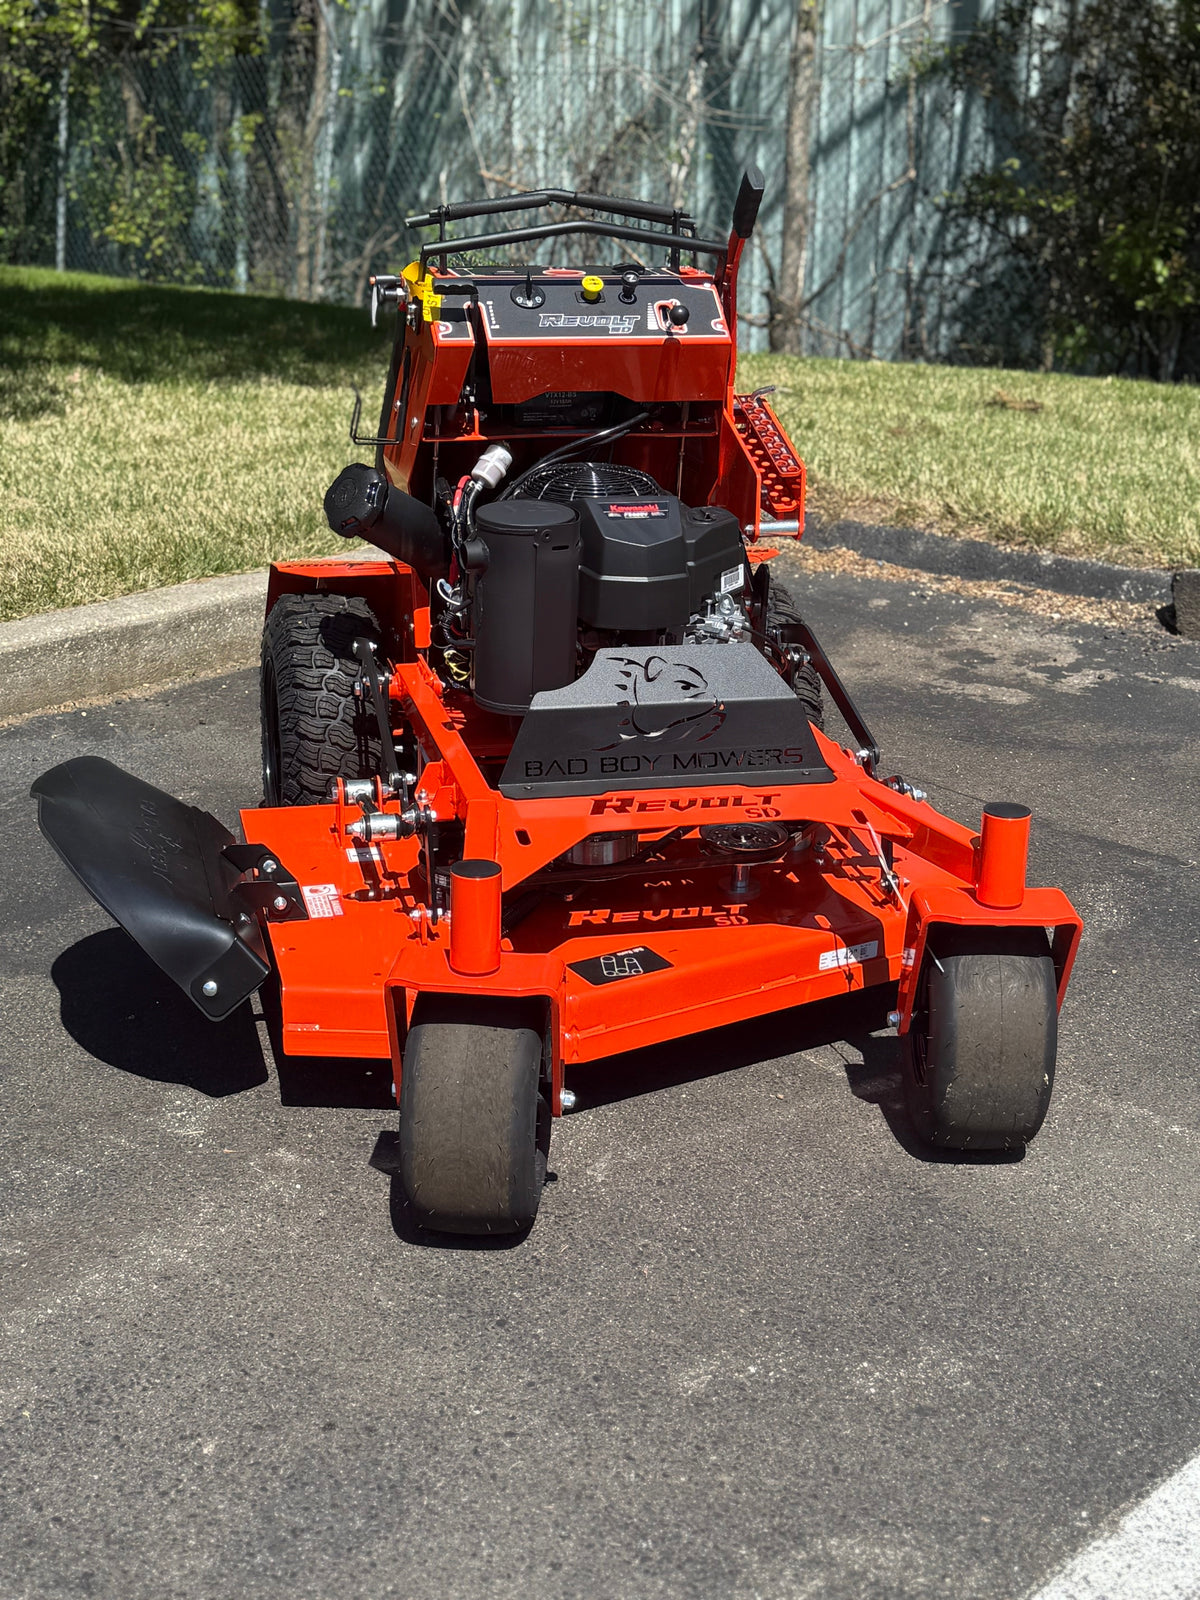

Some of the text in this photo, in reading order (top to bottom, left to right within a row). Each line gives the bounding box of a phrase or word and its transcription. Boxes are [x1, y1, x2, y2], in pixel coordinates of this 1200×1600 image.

[609, 504, 659, 512] Kawasaki
[525, 748, 804, 777] BAD BOY MOWERS
[744, 807, 782, 819] SD
